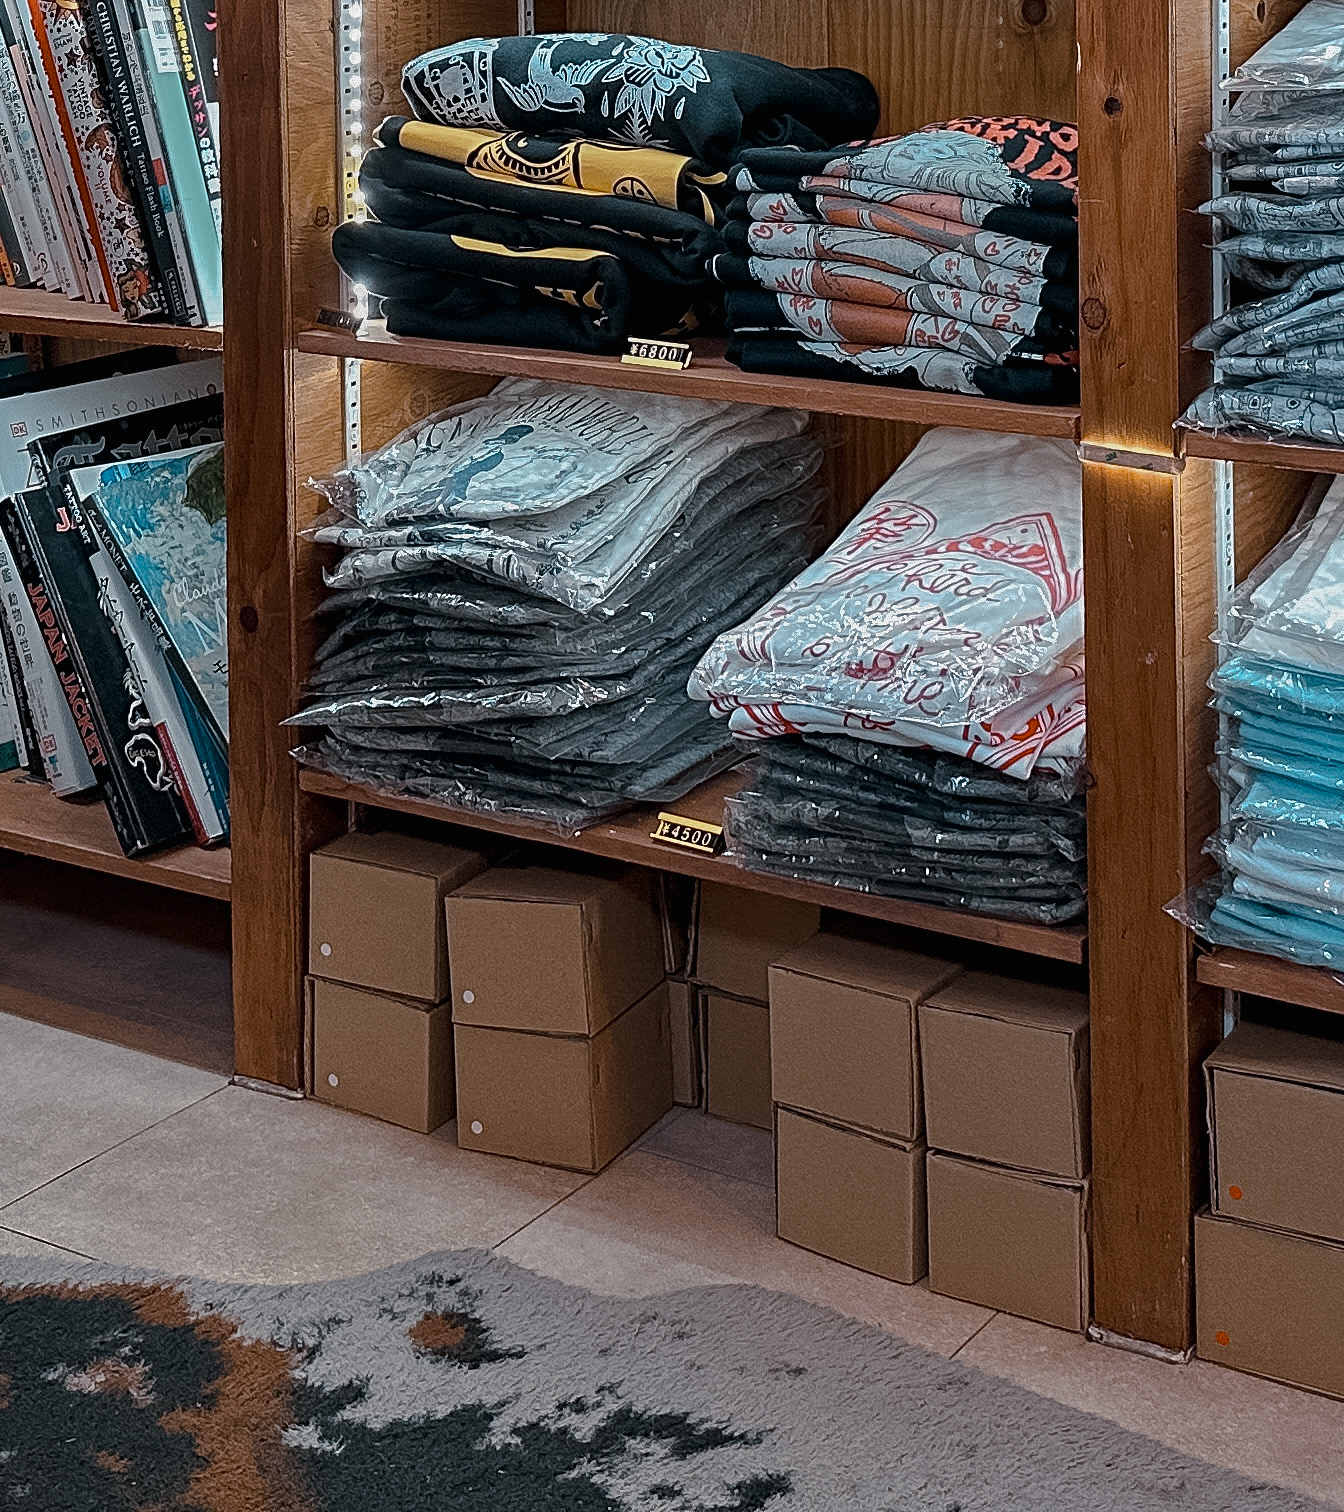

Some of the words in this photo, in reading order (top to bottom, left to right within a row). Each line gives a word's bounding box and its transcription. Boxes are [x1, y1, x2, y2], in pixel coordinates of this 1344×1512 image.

[95, 1, 124, 79] CHRISTIAN
[117, 81, 142, 148] WARLICH
[65, 88, 79, 120] FLASH
[72, 82, 86, 120] TATTOO
[79, 76, 93, 120] VINTAGE
[96, 162, 112, 205] VOLUME
[629, 342, 678, 362] ¥6800
[11, 424, 27, 437] DK
[36, 389, 201, 433] SMITHSONIAN
[62, 483, 83, 522] TATTOO
[78, 521, 92, 545] ART
[100, 531, 128, 572] MONET
[27, 582, 68, 666] JAPAN
[59, 670, 107, 768] JACKET
[662, 822, 712, 846] ¥4500
